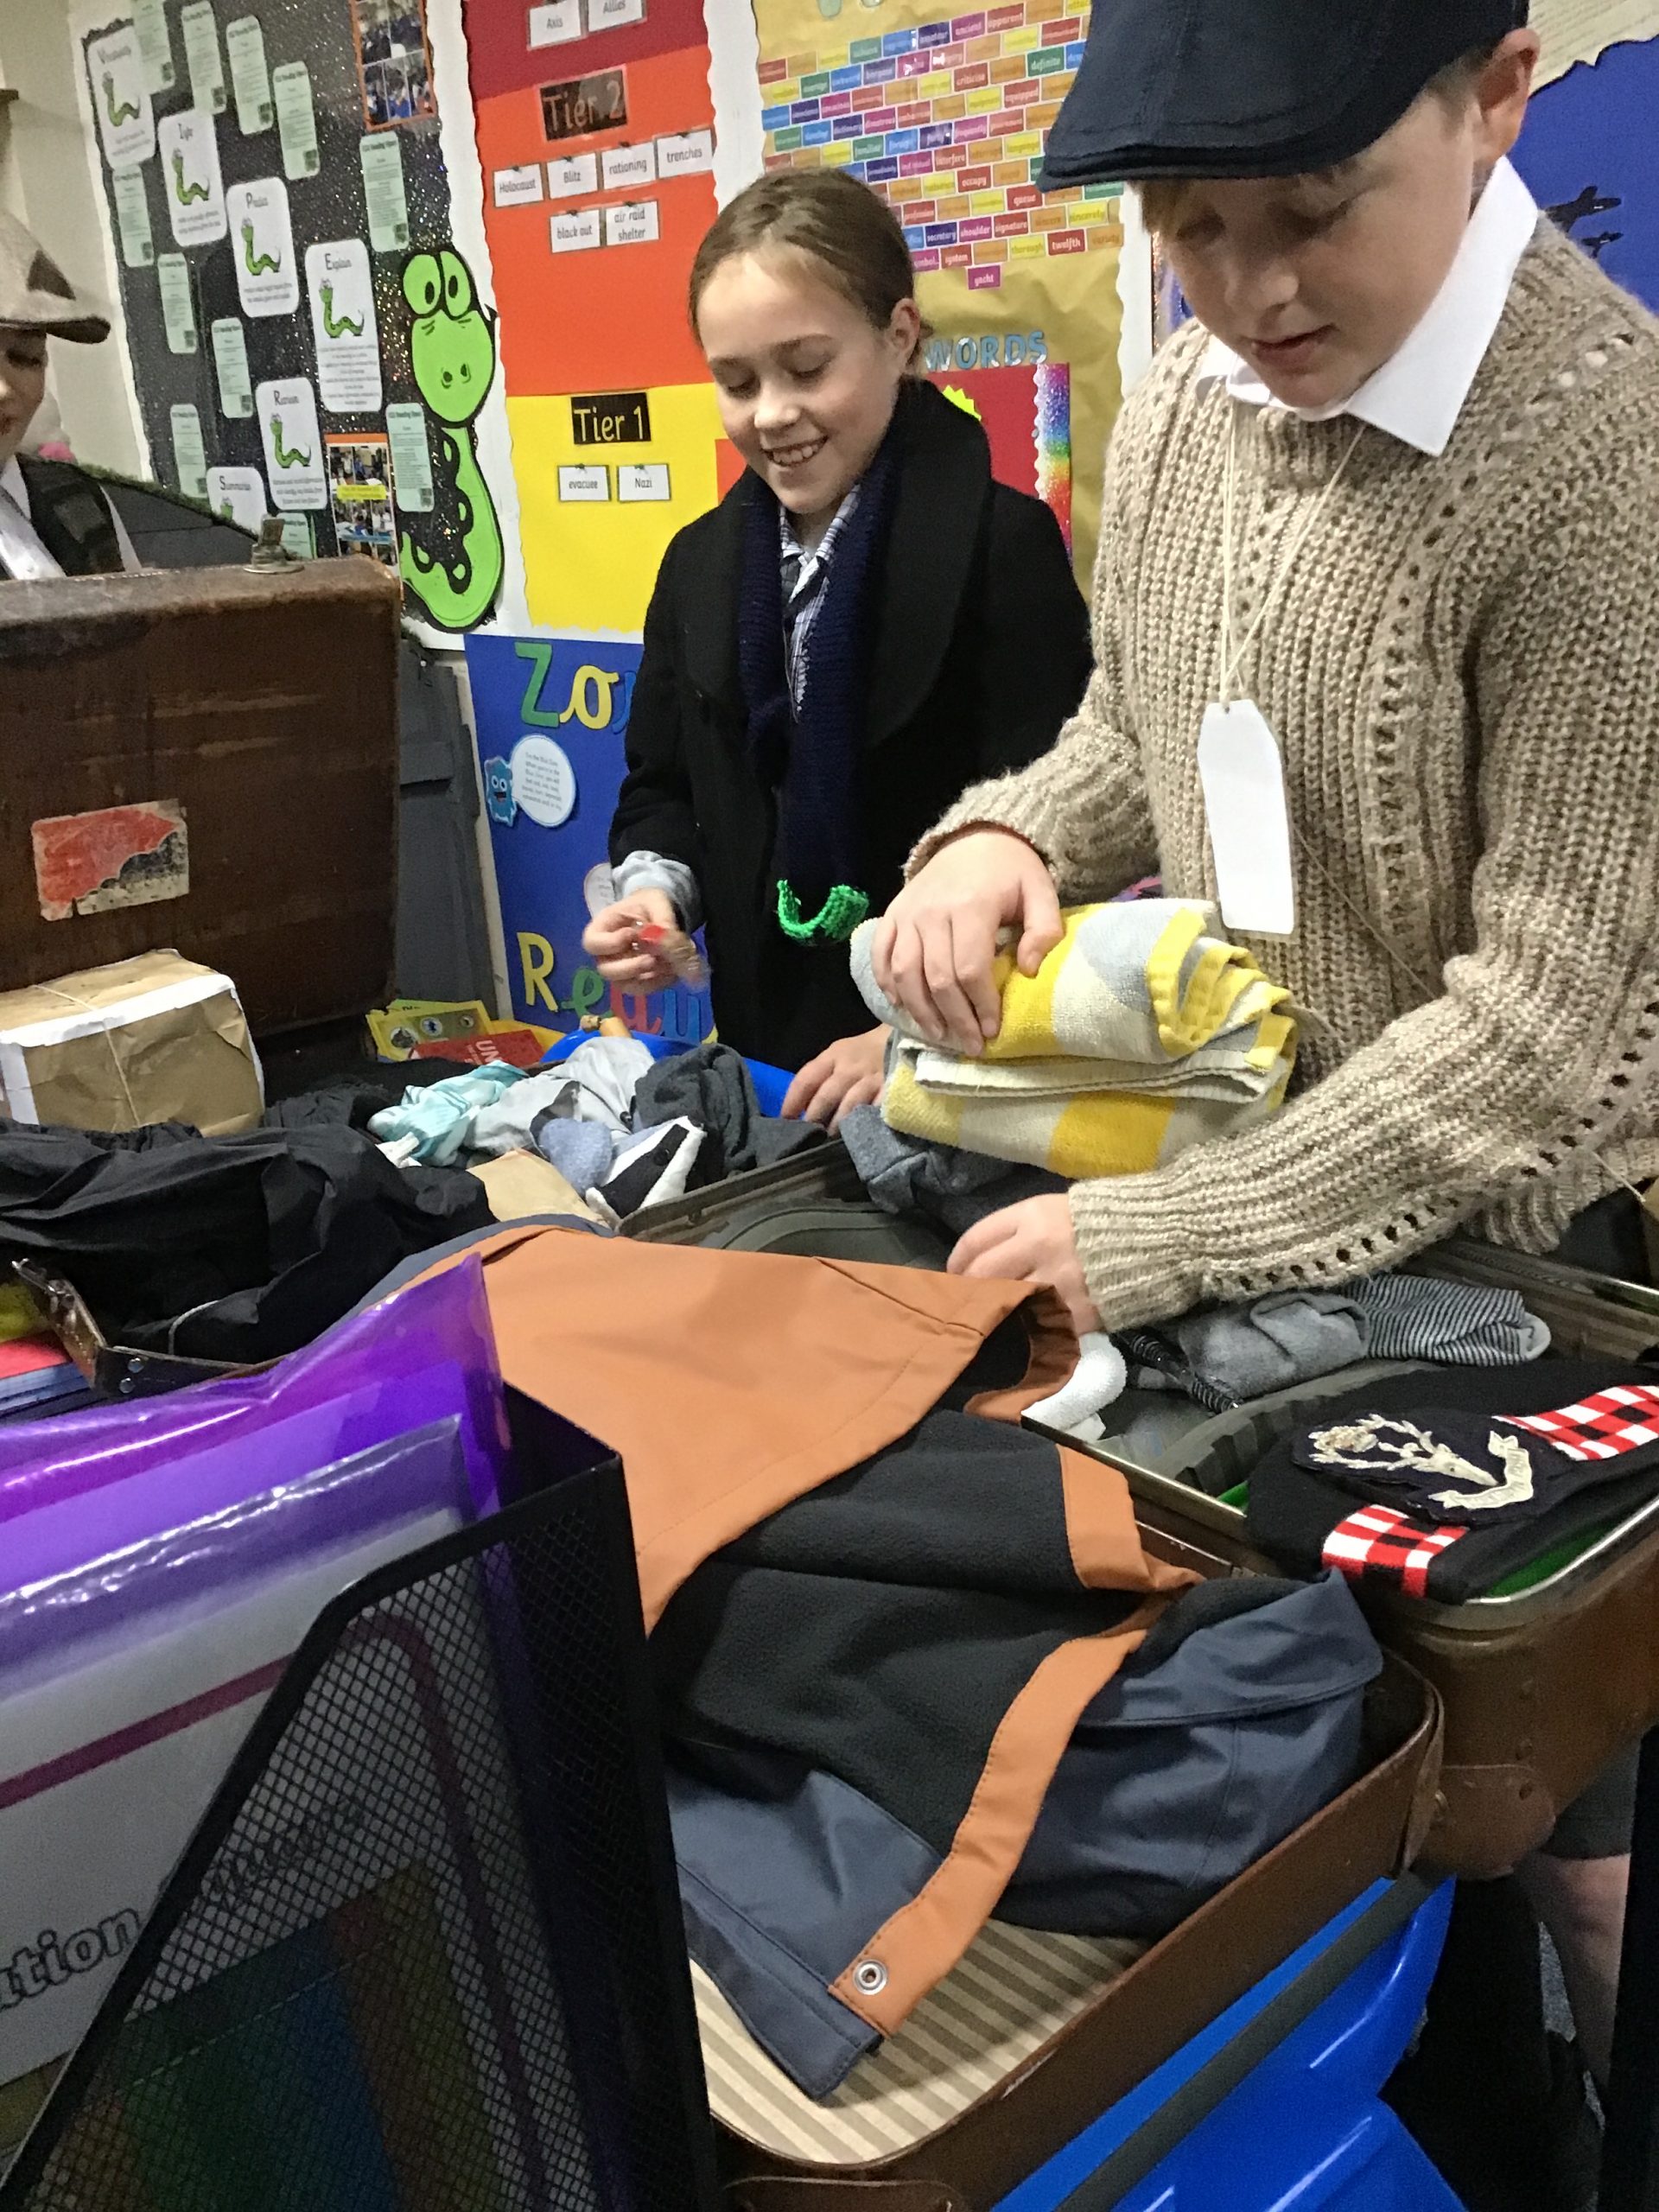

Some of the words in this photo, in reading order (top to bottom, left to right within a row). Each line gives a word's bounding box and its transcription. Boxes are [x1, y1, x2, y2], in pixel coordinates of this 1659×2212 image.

[546, 16, 563, 29] Axis
[1031, 58, 1061, 71] definite
[543, 94, 598, 132] Tier
[606, 79, 625, 121] 2
[666, 146, 702, 163] trenches
[937, 153, 965, 166] interfere
[608, 159, 647, 176] rationing
[563, 171, 581, 183] Blitz
[961, 177, 988, 188] occupy
[499, 179, 537, 194] Holocaust
[1013, 194, 1037, 207] queue
[614, 213, 626, 223] air
[628, 209, 645, 221] raid
[556, 226, 578, 239] black
[580, 226, 593, 236] out
[959, 226, 991, 238] shoulder
[995, 220, 1027, 233] signature
[618, 228, 645, 241] shelter
[926, 232, 957, 243] secretary
[1052, 238, 1081, 251] twelfth
[973, 272, 995, 286] yacht
[924, 330, 1048, 372] WORDS
[574, 406, 625, 442] Tier
[633, 405, 644, 440] 1
[569, 480, 598, 490] evacuee
[634, 477, 652, 488] Nazi
